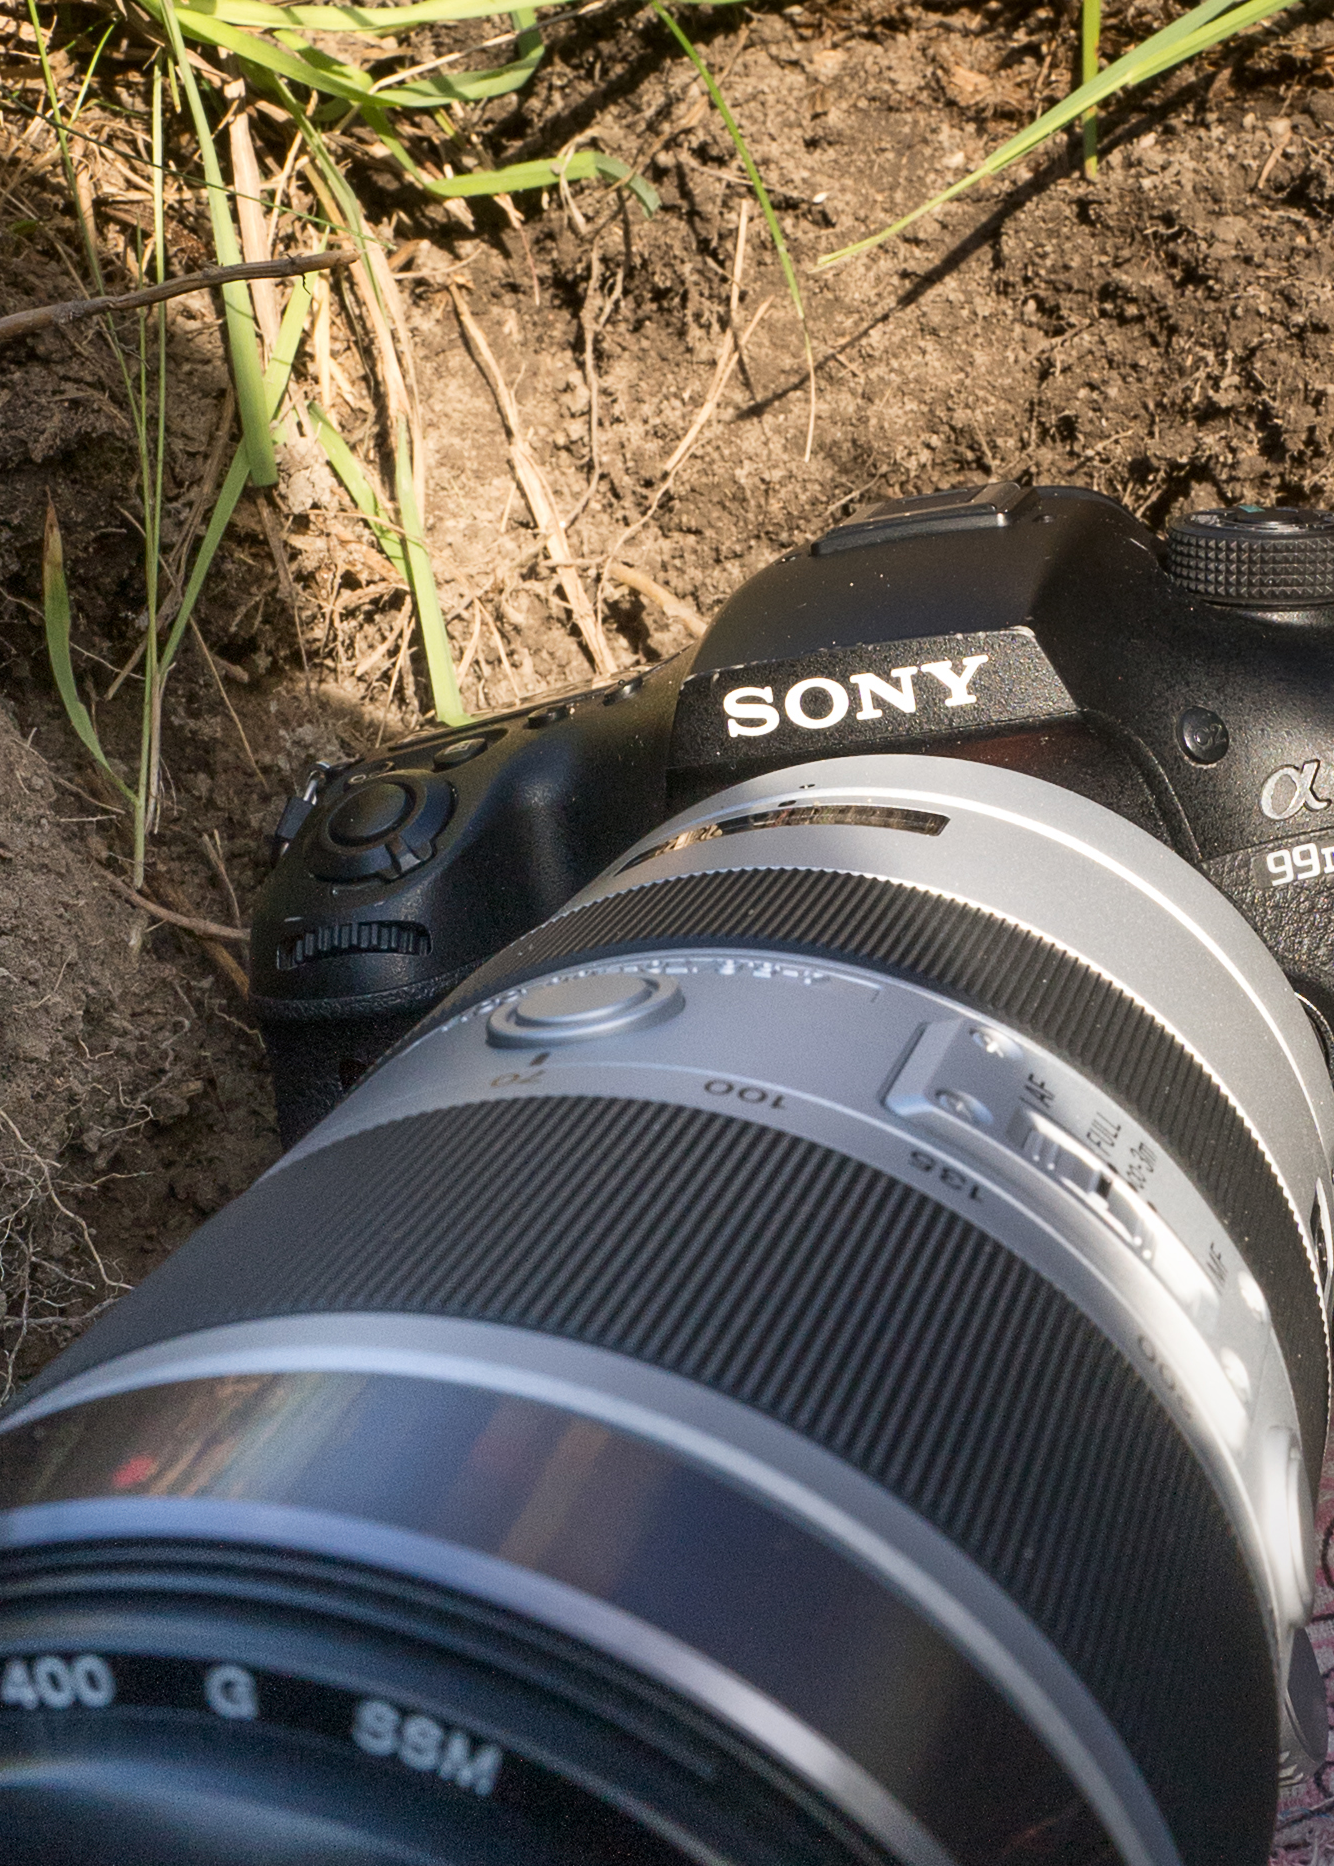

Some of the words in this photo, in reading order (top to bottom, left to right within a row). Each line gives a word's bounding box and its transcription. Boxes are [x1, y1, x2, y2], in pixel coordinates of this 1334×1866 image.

[723, 653, 990, 739] SONY
[703, 1078, 786, 1111] 100
[1025, 1073, 1057, 1110] AF
[1085, 1112, 1122, 1160] FULL
[907, 1150, 983, 1201] 135
[203, 1662, 259, 1722] G
[351, 1698, 505, 1798] SSM
